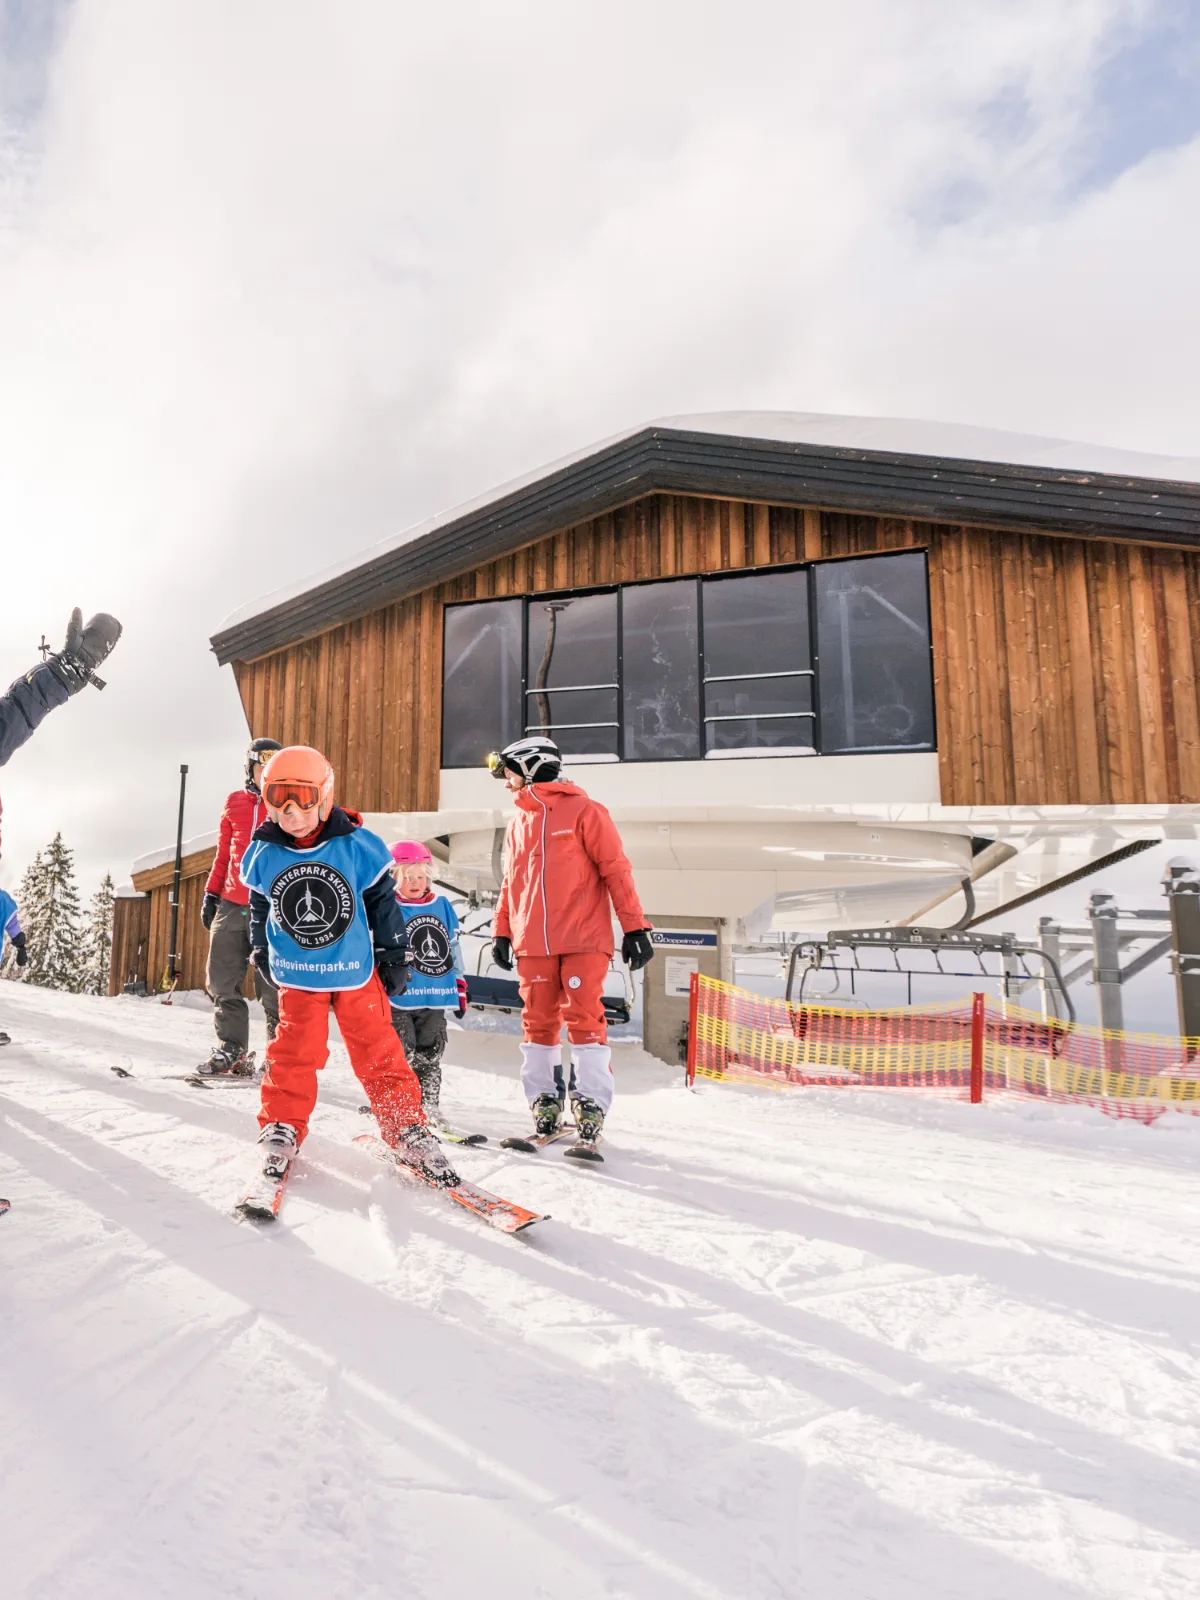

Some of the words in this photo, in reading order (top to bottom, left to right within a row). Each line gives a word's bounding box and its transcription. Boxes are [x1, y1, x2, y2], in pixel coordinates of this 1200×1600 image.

[272, 866, 328, 896] VINTERPARK
[327, 872, 351, 920] SKISKOLE
[314, 931, 334, 945] 1934
[663, 936, 705, 946] Doppelmayr
[275, 959, 360, 974] oslovinterpark.no
